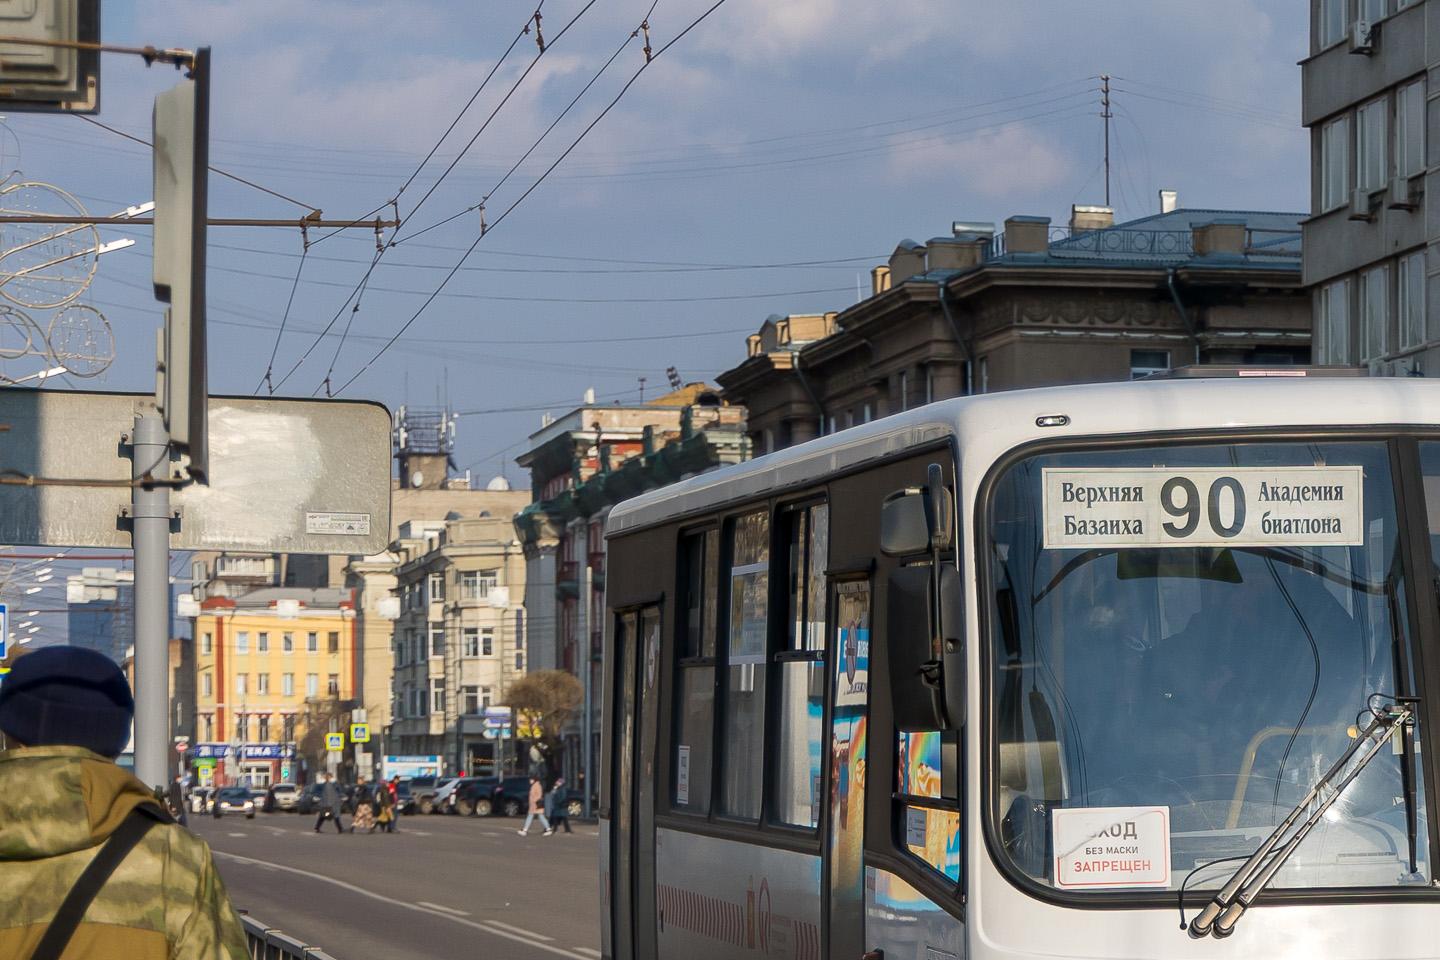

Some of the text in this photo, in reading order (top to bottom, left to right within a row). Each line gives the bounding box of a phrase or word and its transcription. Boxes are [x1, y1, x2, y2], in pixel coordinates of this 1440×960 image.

[1061, 481, 1144, 508] Верхняя
[1257, 479, 1344, 505] Академия
[1160, 476, 1247, 539] 90
[1063, 514, 1144, 536] Базаиха
[1261, 510, 1343, 536] биатлона
[1091, 821, 1138, 840] ХОД
[1085, 846, 1139, 855] БЕЗ МАСКИ
[1074, 860, 1151, 873] ЗАПРЕЩЕН
